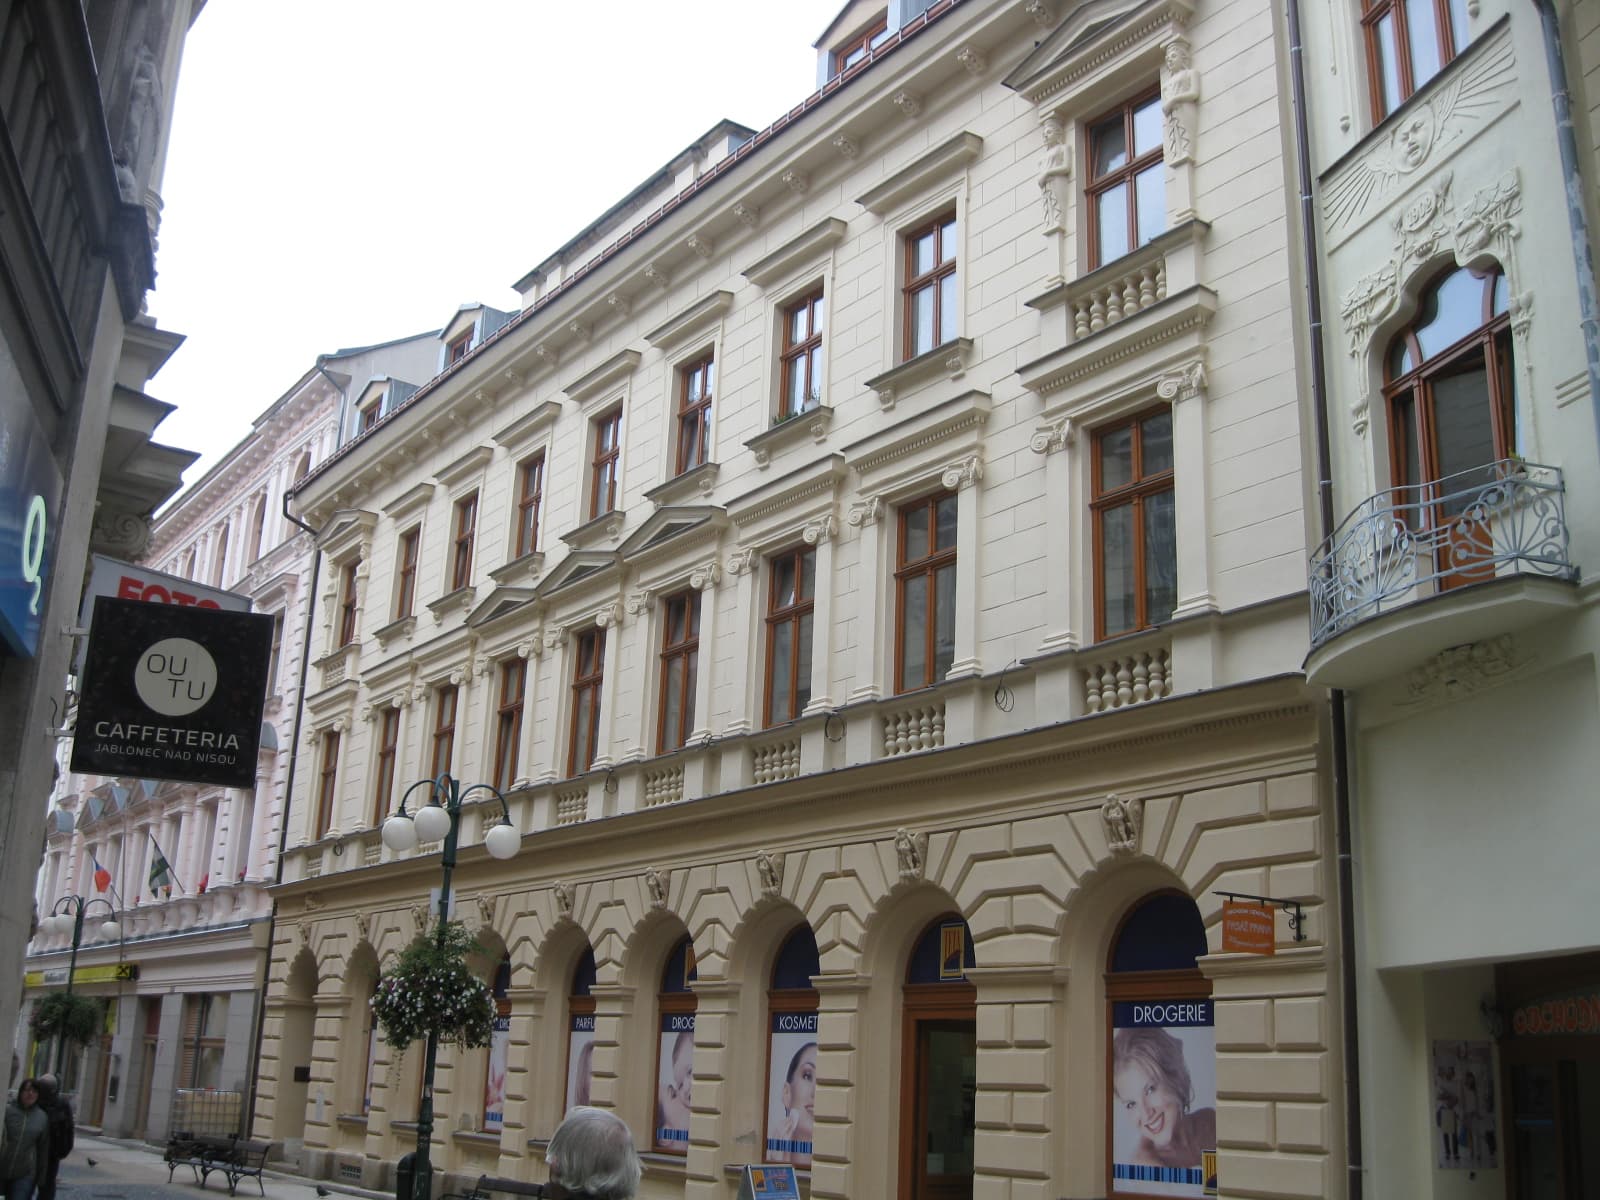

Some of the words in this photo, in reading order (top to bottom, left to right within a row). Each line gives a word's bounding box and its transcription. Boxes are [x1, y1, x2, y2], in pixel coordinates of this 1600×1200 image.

[147, 653, 187, 676] OU
[167, 678, 206, 701] TU
[95, 721, 240, 750] CAFFETERIA
[95, 743, 161, 758] JABLONEC
[165, 749, 191, 761] NAD
[196, 753, 236, 765] NISOU
[779, 1015, 818, 1030] KOSMET
[1134, 1004, 1206, 1023] DROGERIE
